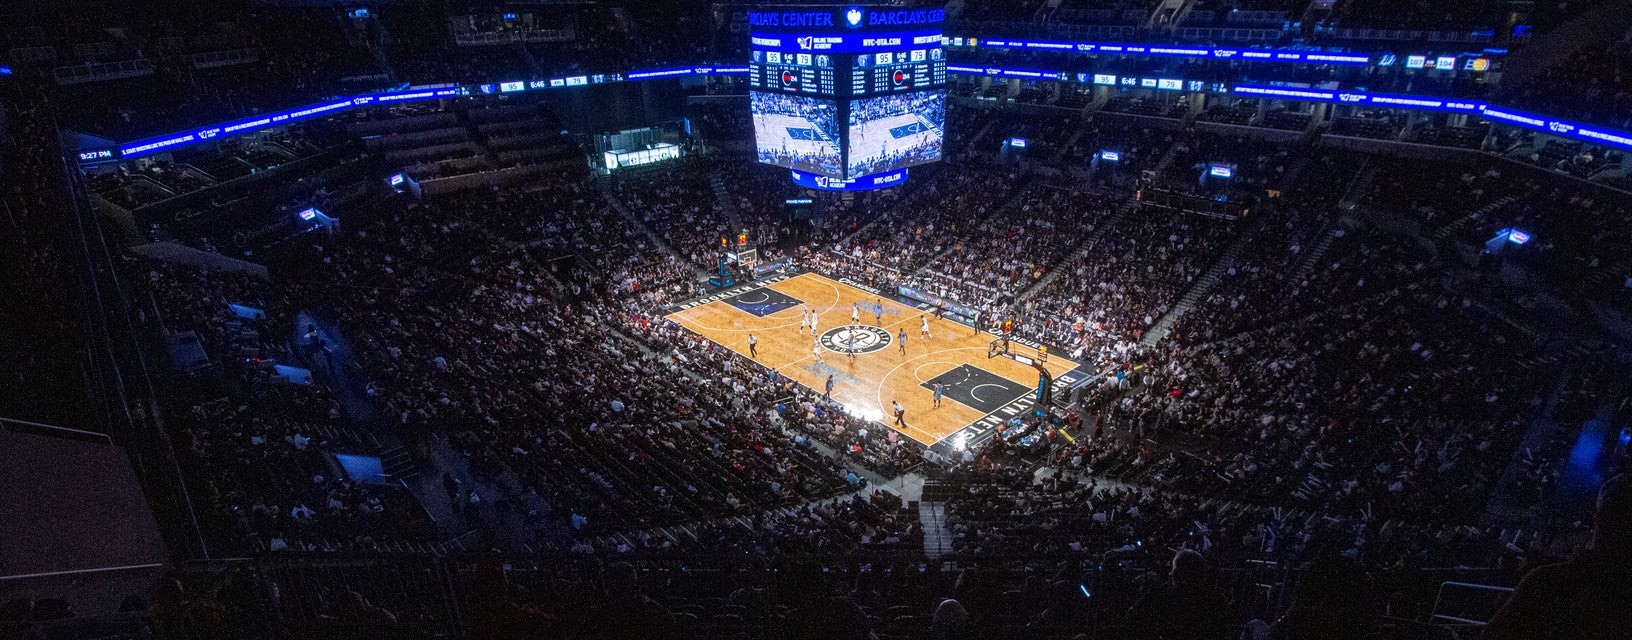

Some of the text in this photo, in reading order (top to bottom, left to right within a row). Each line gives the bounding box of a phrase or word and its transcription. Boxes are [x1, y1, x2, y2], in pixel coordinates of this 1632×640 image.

[782, 12, 834, 26] CENTER
[869, 10, 926, 25] BARCLAYS
[863, 38, 901, 46] NYC-OTA.COM
[800, 55, 808, 63] 79
[880, 54, 888, 63] 95
[680, 276, 790, 310] BROOKLYN NETS
[960, 414, 1003, 440] NETS
